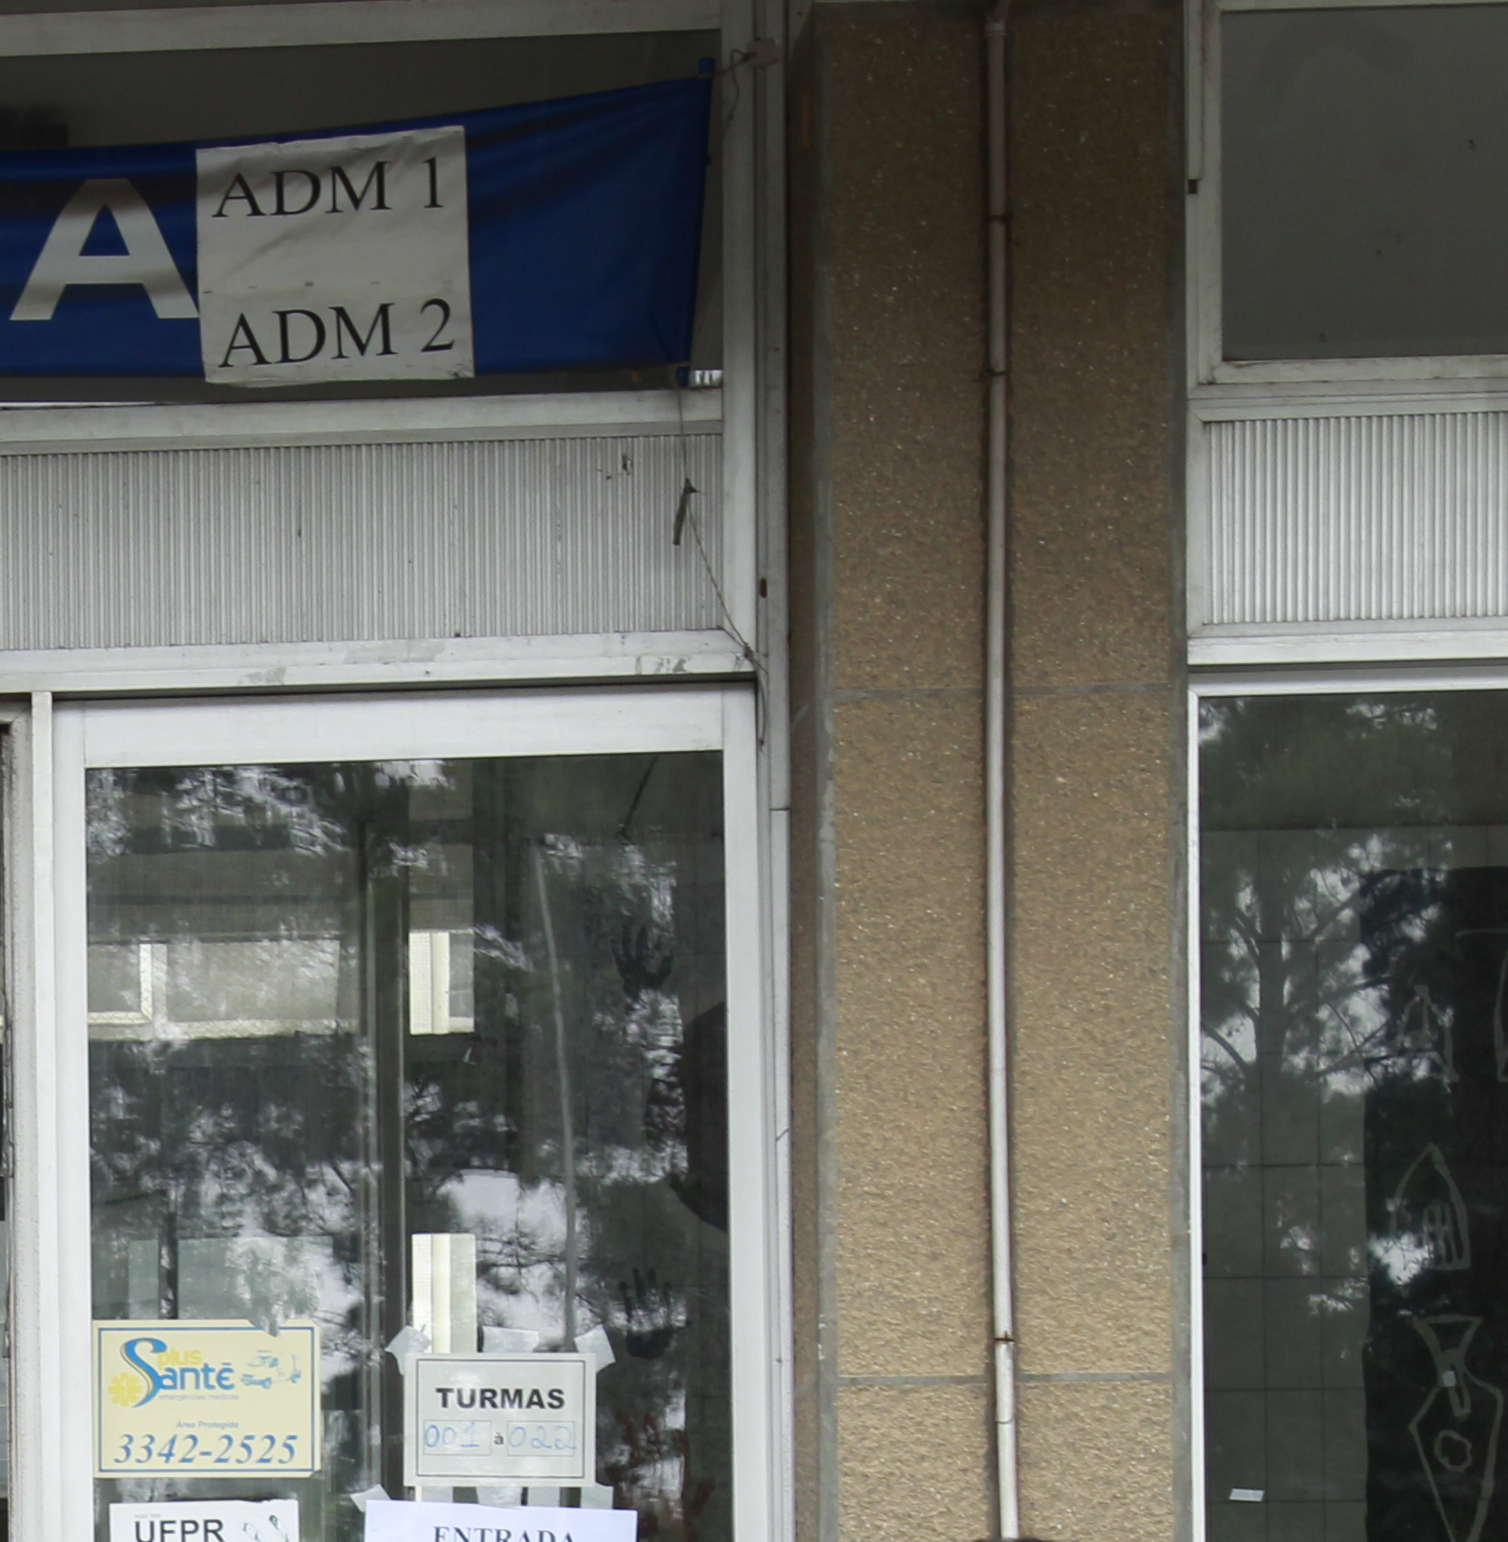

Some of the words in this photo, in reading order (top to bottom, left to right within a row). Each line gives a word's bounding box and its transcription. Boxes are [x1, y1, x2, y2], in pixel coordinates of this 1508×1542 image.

[212, 161, 392, 217] ADM
[423, 157, 444, 209] 1
[218, 303, 398, 368] ADM
[420, 298, 455, 353] 2
[158, 1347, 203, 1369] plus
[436, 1388, 565, 1409] TURMAS
[113, 1433, 299, 1464] 3342-2525
[424, 1421, 480, 1448] 001
[509, 1426, 577, 1450] 022
